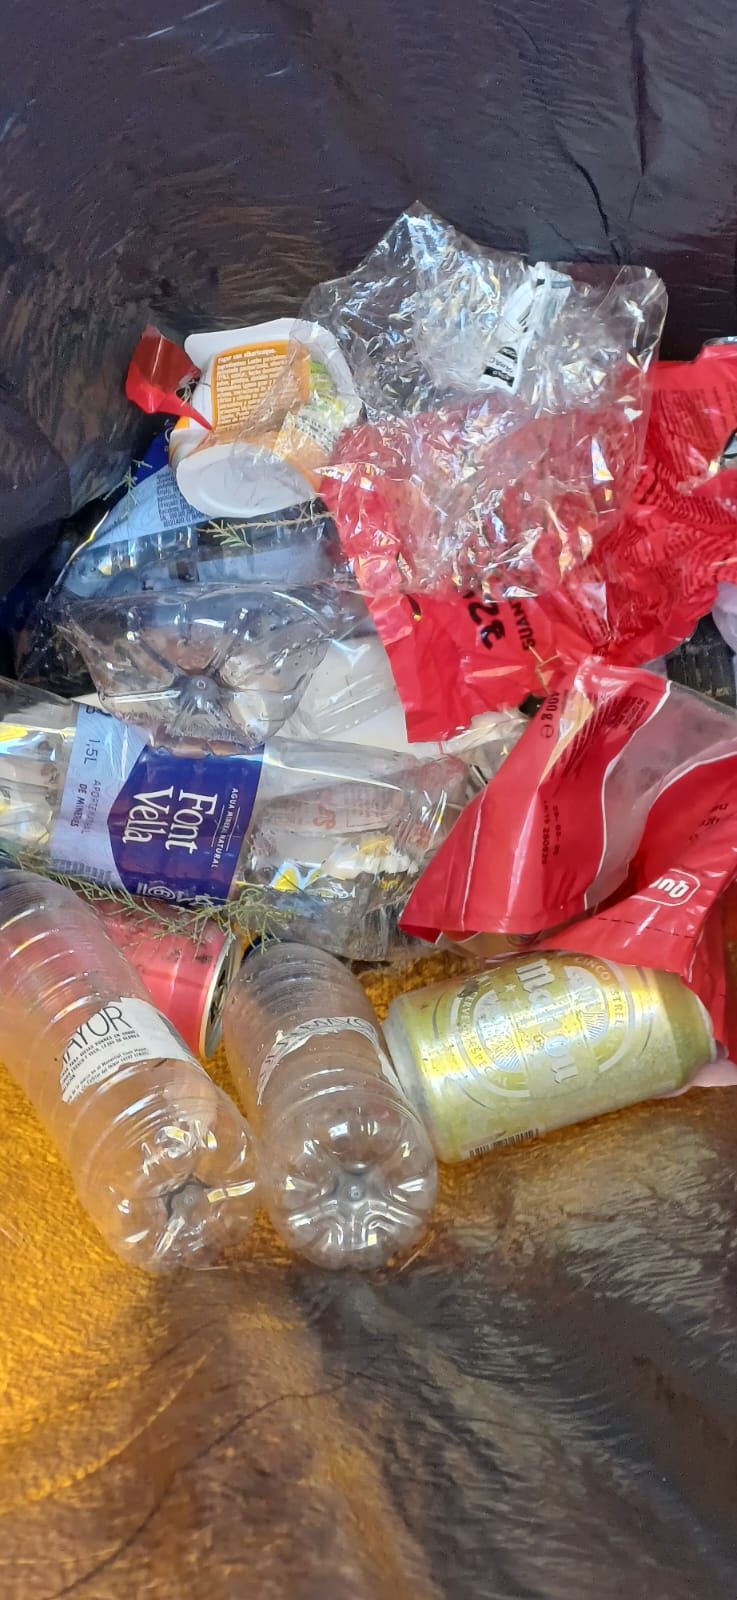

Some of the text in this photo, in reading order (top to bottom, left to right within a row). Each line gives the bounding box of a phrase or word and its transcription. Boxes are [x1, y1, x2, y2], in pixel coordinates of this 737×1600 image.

[84, 738, 101, 765] 1,5L
[78, 783, 88, 794] DE
[229, 787, 239, 810] AGUA
[122, 786, 174, 844] Vella
[165, 789, 218, 854] Font
[211, 834, 228, 868] NATURAL
[62, 1005, 132, 1064] AYOR
